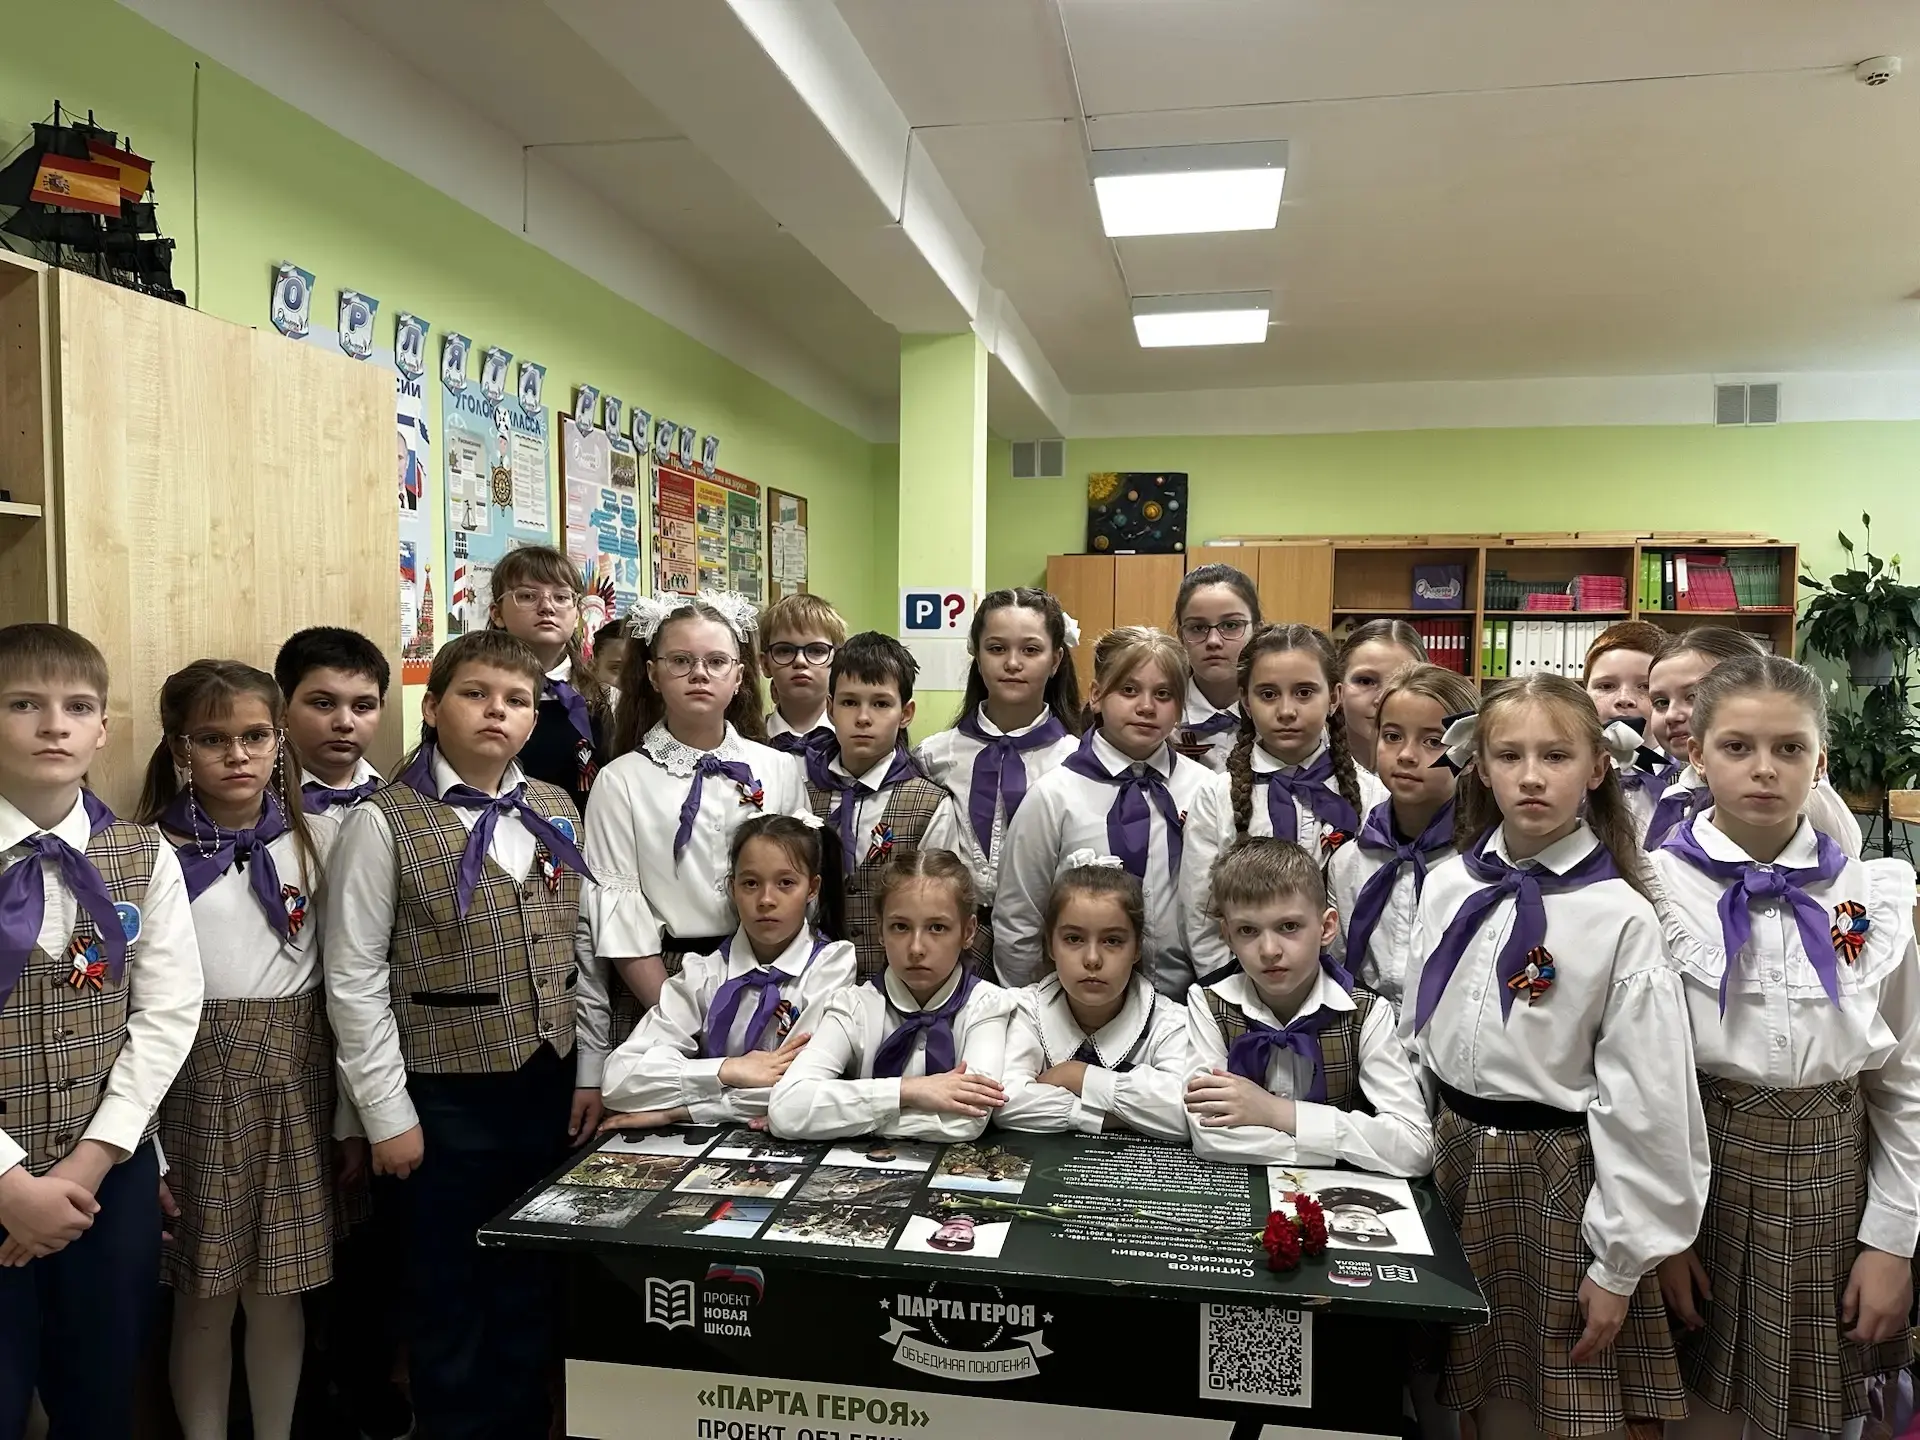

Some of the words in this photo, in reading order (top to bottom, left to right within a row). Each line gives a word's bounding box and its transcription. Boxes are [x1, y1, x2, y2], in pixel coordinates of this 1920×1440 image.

[1111, 1249, 1189, 1262] Сергеевич
[1192, 1255, 1254, 1267] Алексей
[1168, 1263, 1255, 1278] Ситников
[703, 1291, 751, 1306] ПРОЕКТ
[704, 1307, 748, 1321] НОВАЯ
[897, 1293, 965, 1320] ПАРТА
[970, 1302, 1035, 1327] ГЕРОЯ
[704, 1322, 752, 1337] ШКОЛА
[697, 1384, 809, 1417] «ПАРТА
[816, 1393, 930, 1428] ГЕРОЯ»
